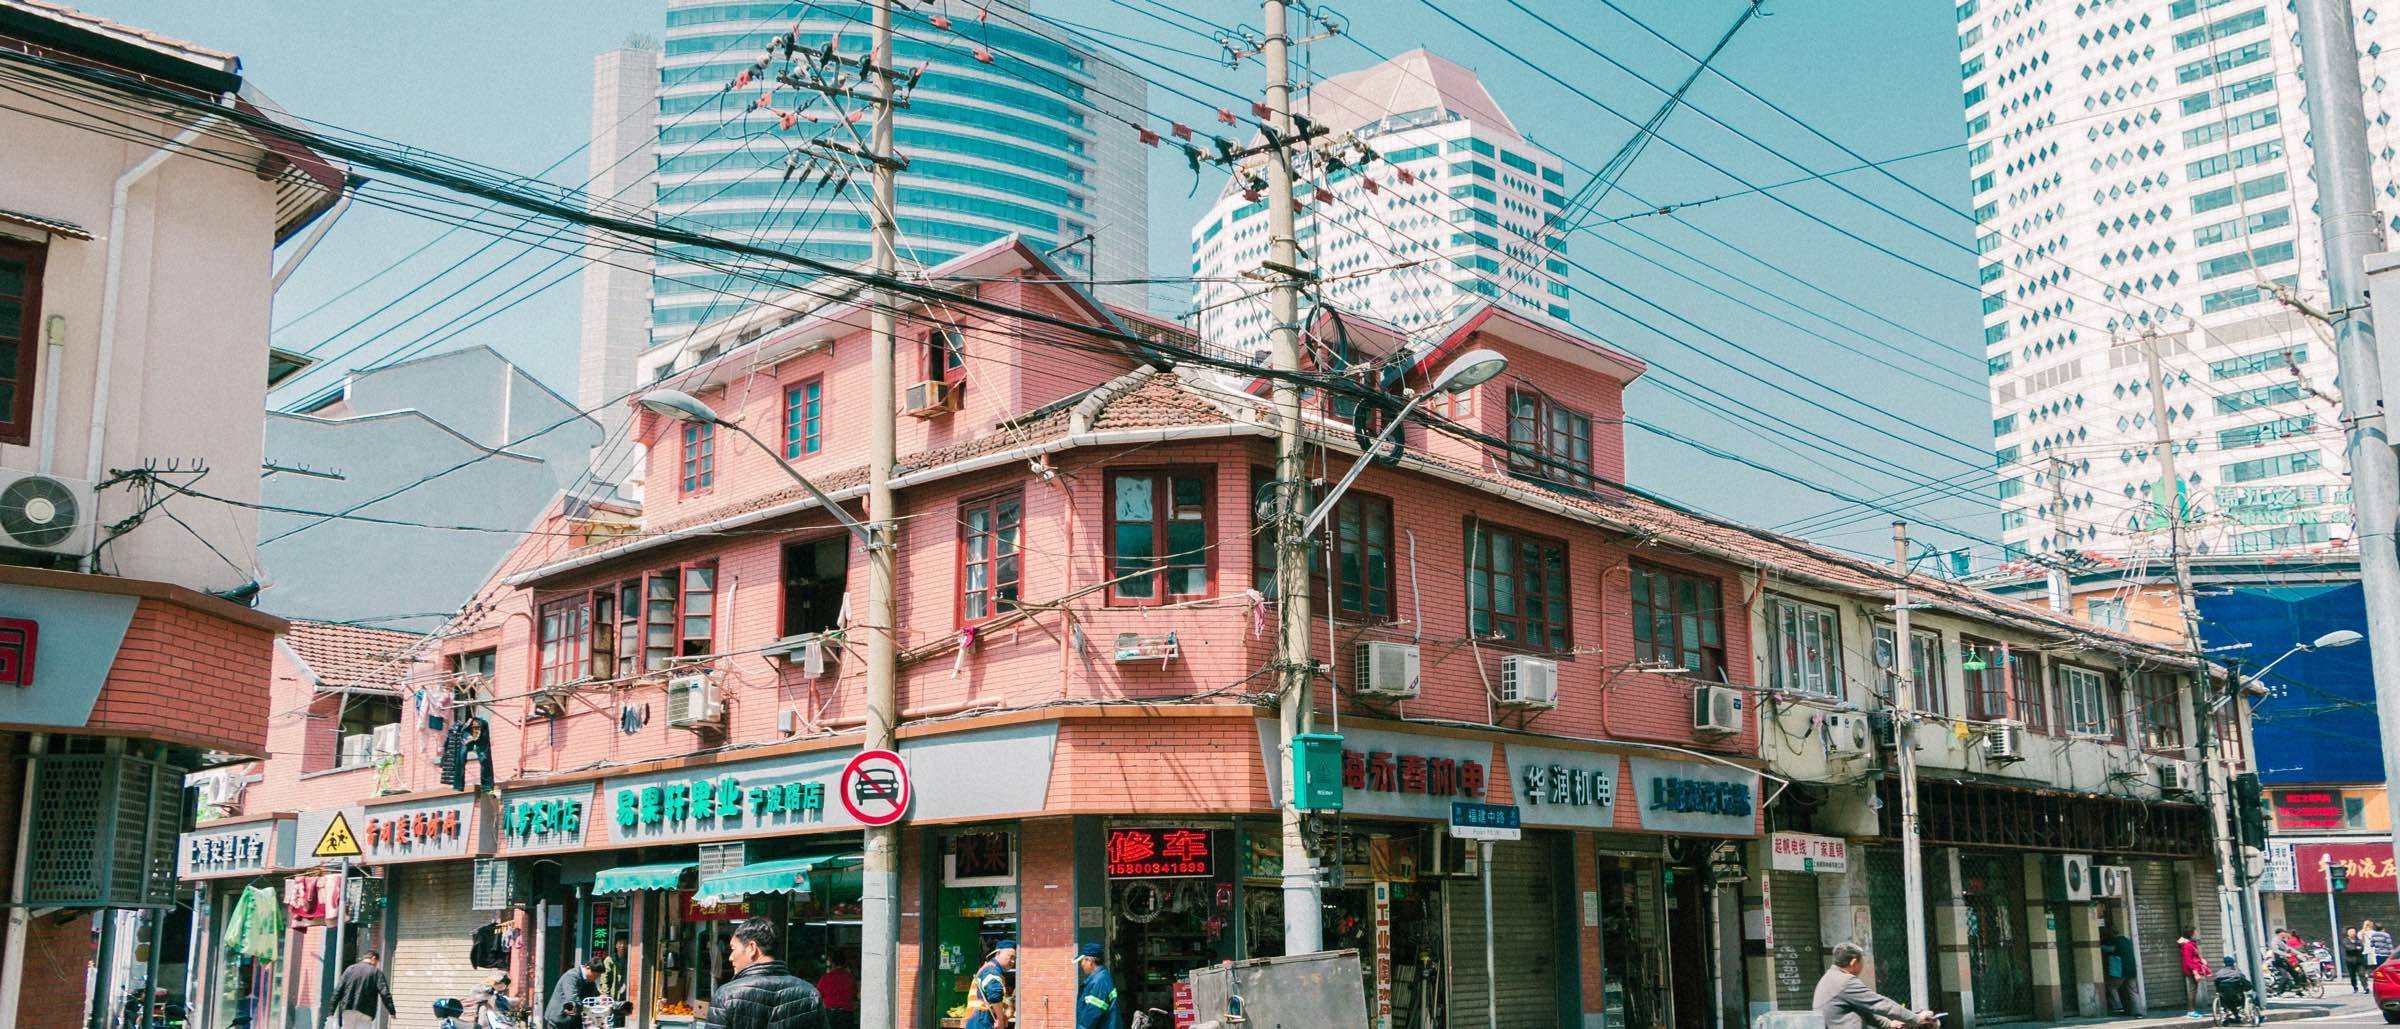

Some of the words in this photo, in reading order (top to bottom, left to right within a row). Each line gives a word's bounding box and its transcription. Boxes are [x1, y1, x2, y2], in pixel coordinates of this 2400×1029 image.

[748, 782, 821, 815] 宁波路店
[1528, 766, 1613, 807] 华润机电
[1468, 809, 1505, 825] 福建中路
[1107, 830, 1208, 863] 修车
[1813, 840, 1844, 859] 厂家直销
